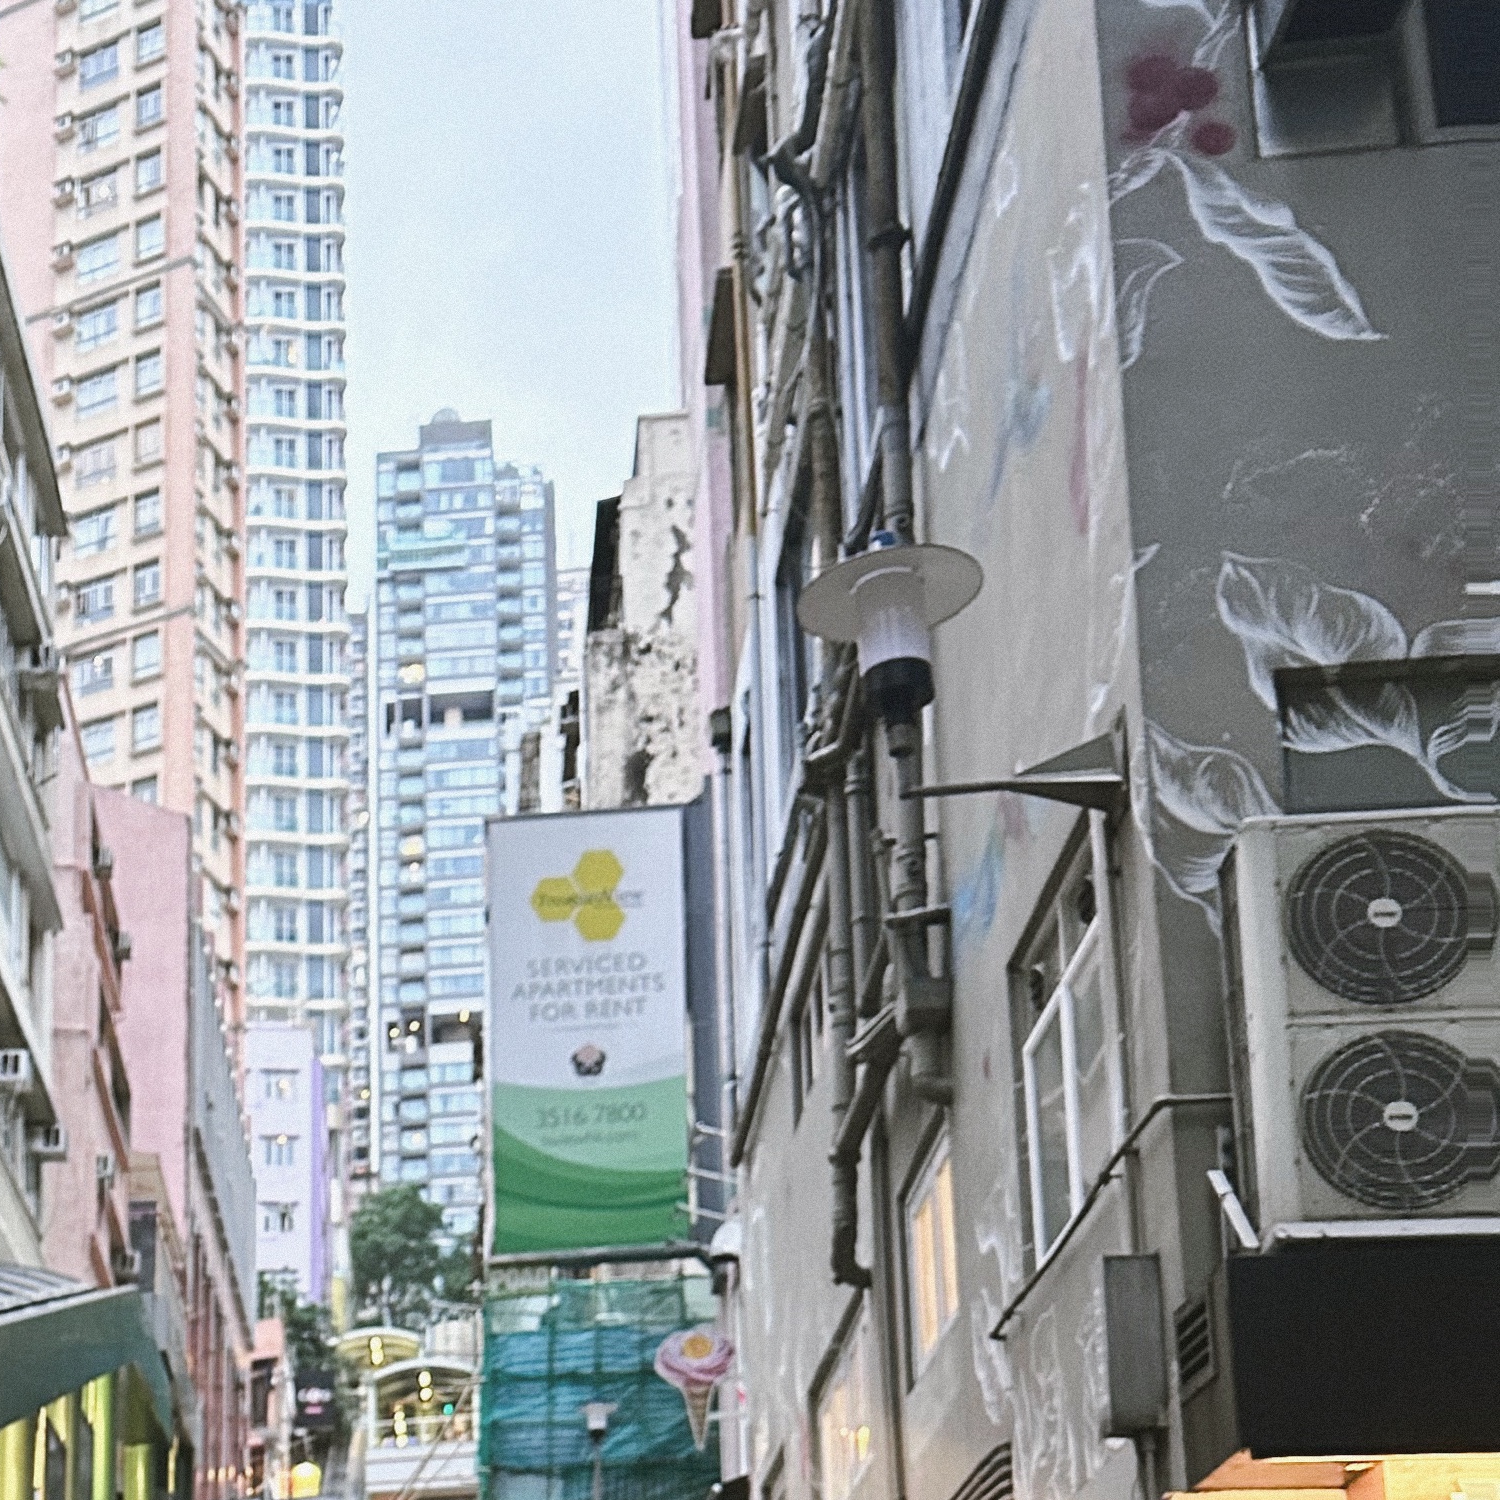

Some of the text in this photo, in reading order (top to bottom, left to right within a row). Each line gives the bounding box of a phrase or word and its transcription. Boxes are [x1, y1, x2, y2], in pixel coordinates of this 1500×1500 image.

[526, 952, 648, 979] SERVICED
[510, 973, 665, 1001] APARTMENTS
[529, 996, 647, 1022] FOR RENT
